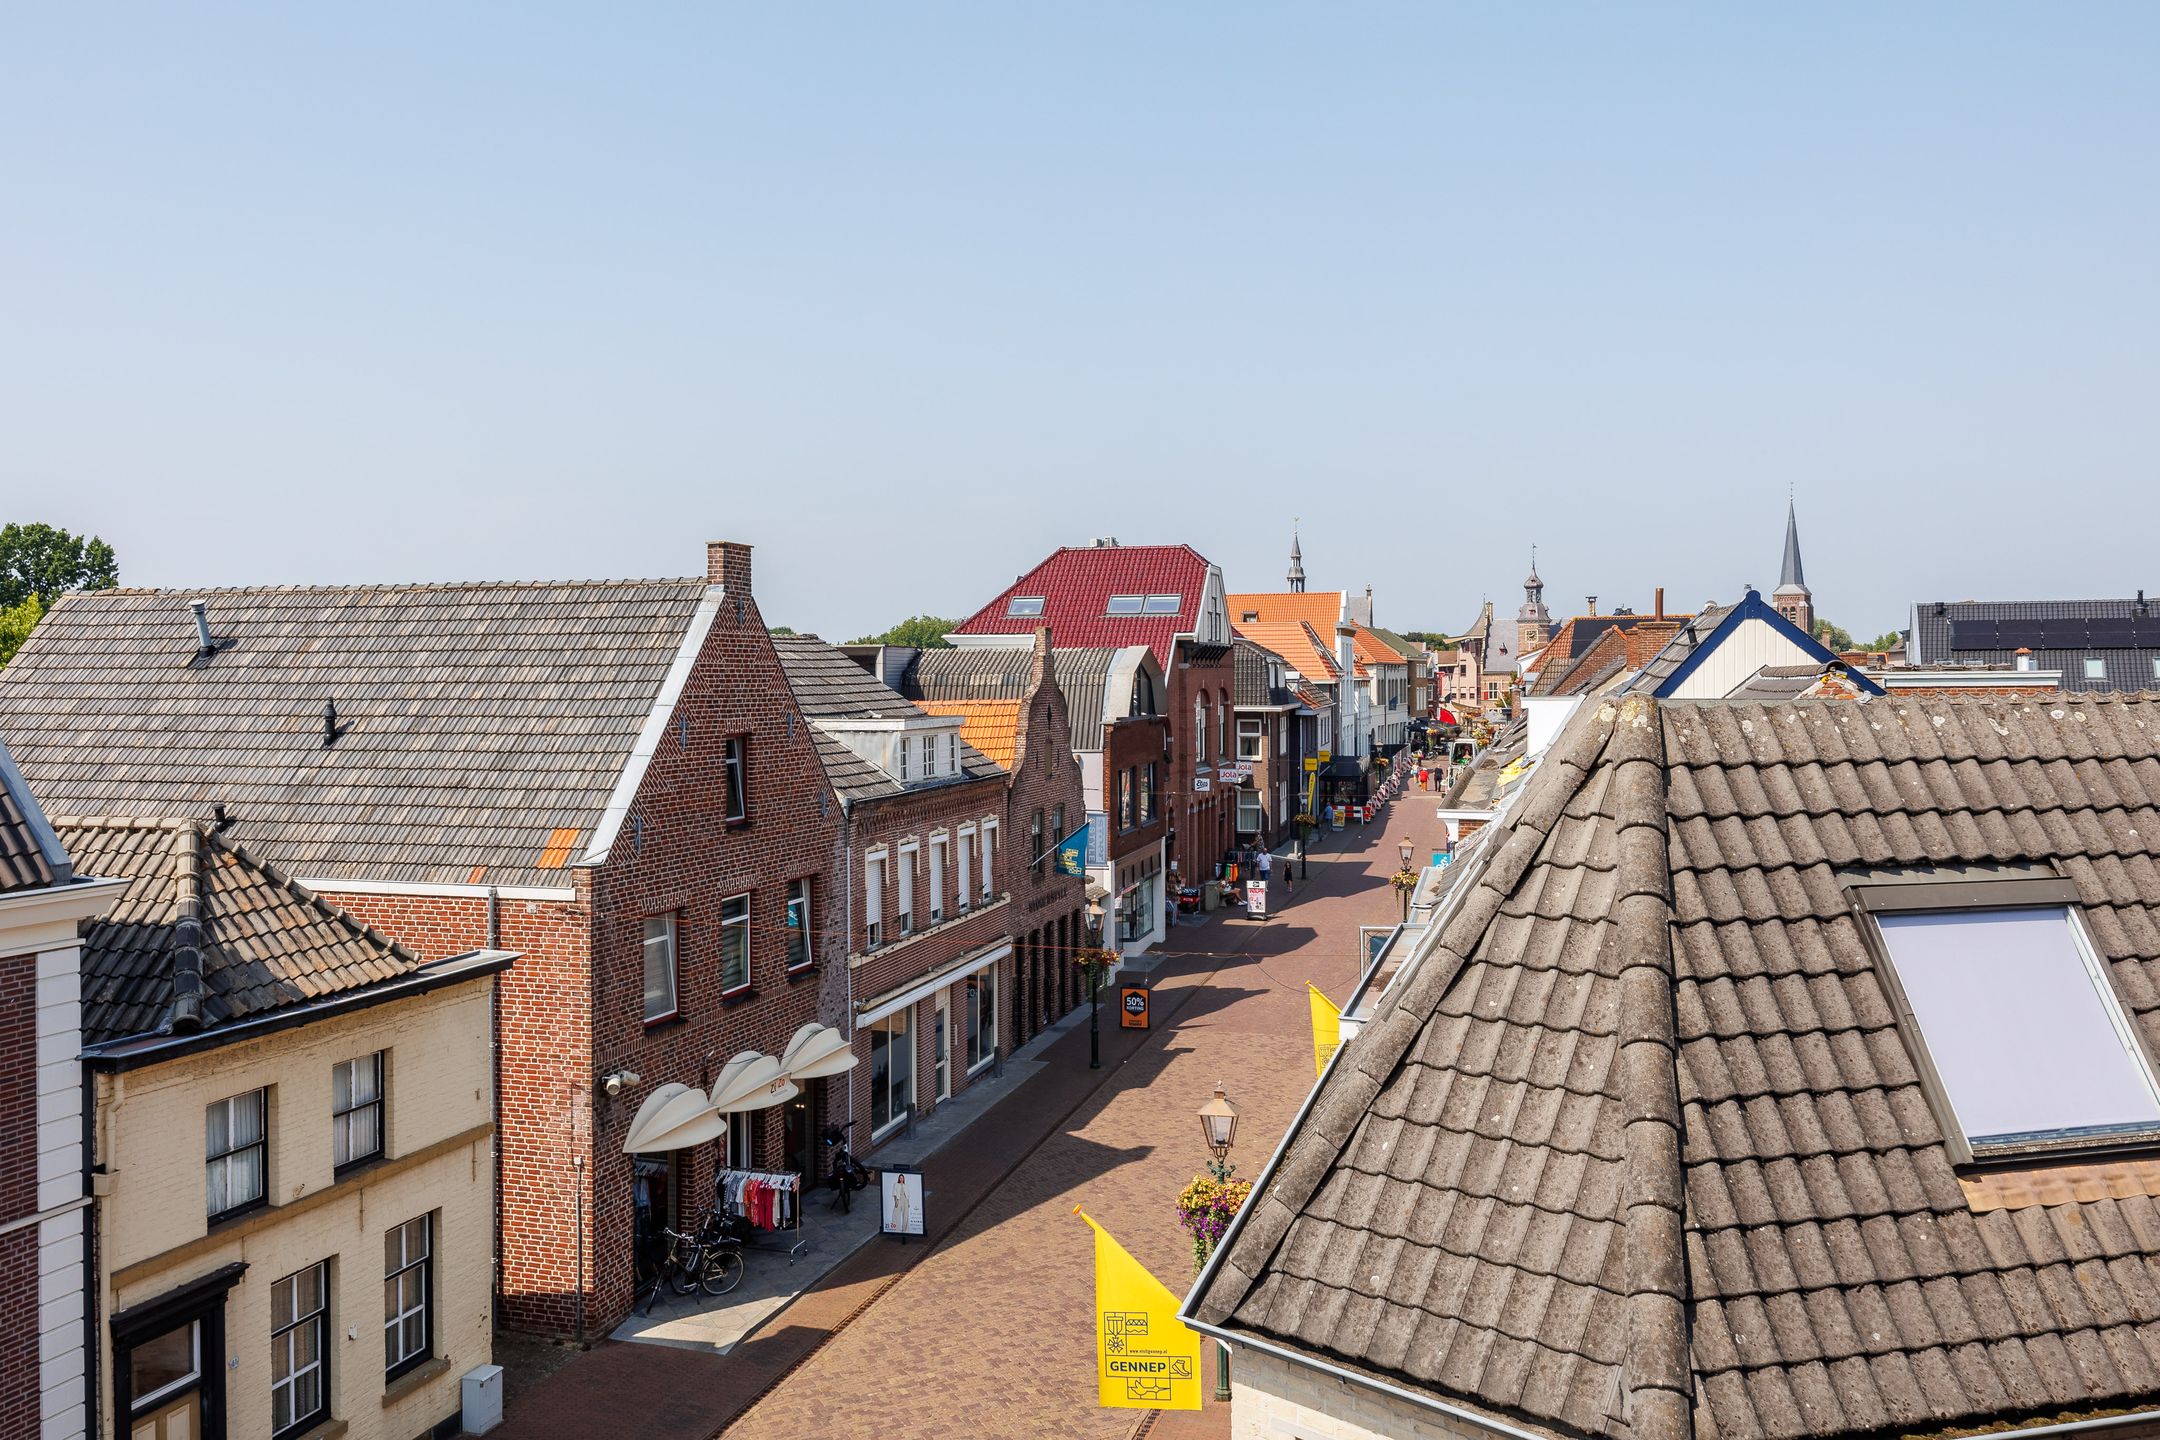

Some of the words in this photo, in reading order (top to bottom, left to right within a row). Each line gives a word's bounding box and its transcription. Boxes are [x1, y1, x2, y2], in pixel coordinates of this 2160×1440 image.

[1221, 771, 1237, 779] Jola
[1126, 997, 1145, 1006] 50%
[1110, 1361, 1166, 1373] GENNEP
